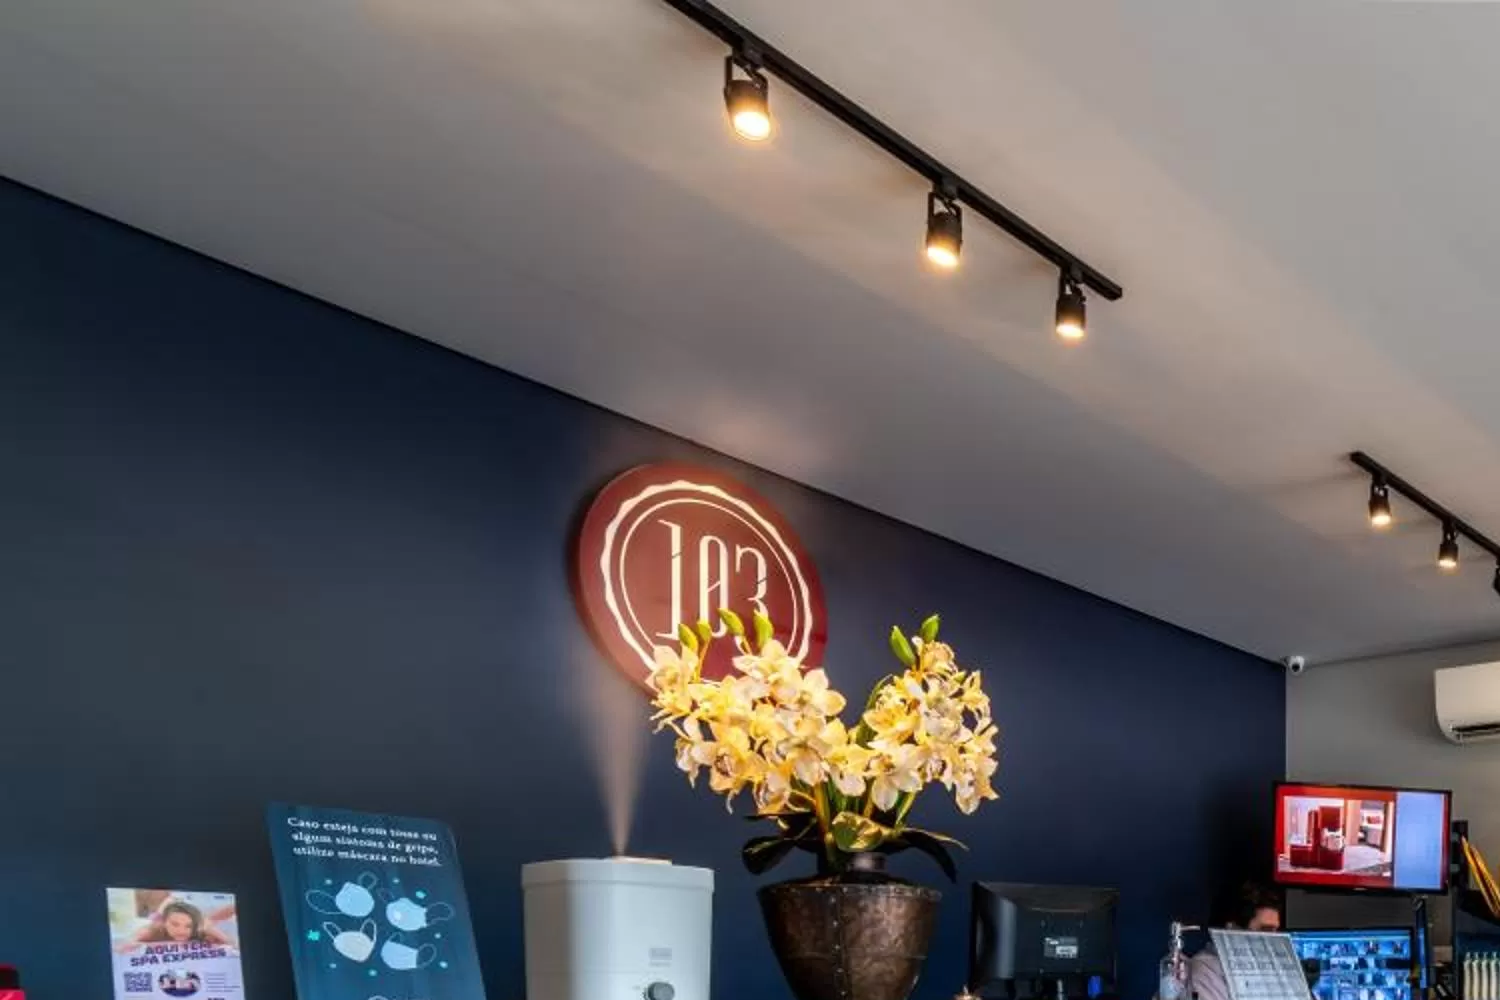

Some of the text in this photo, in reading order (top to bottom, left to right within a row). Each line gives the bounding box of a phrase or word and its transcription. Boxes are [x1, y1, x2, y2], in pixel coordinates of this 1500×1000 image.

[287, 816, 320, 829] Caso
[322, 821, 359, 834] esteja
[361, 826, 387, 835] com
[421, 832, 437, 841] ou
[291, 830, 332, 845] algum
[387, 840, 401, 850] de
[292, 845, 334, 857] utilize
[391, 855, 406, 863] no
[130, 947, 227, 967] SPA EXPRESS
[145, 943, 179, 955] AQUI
